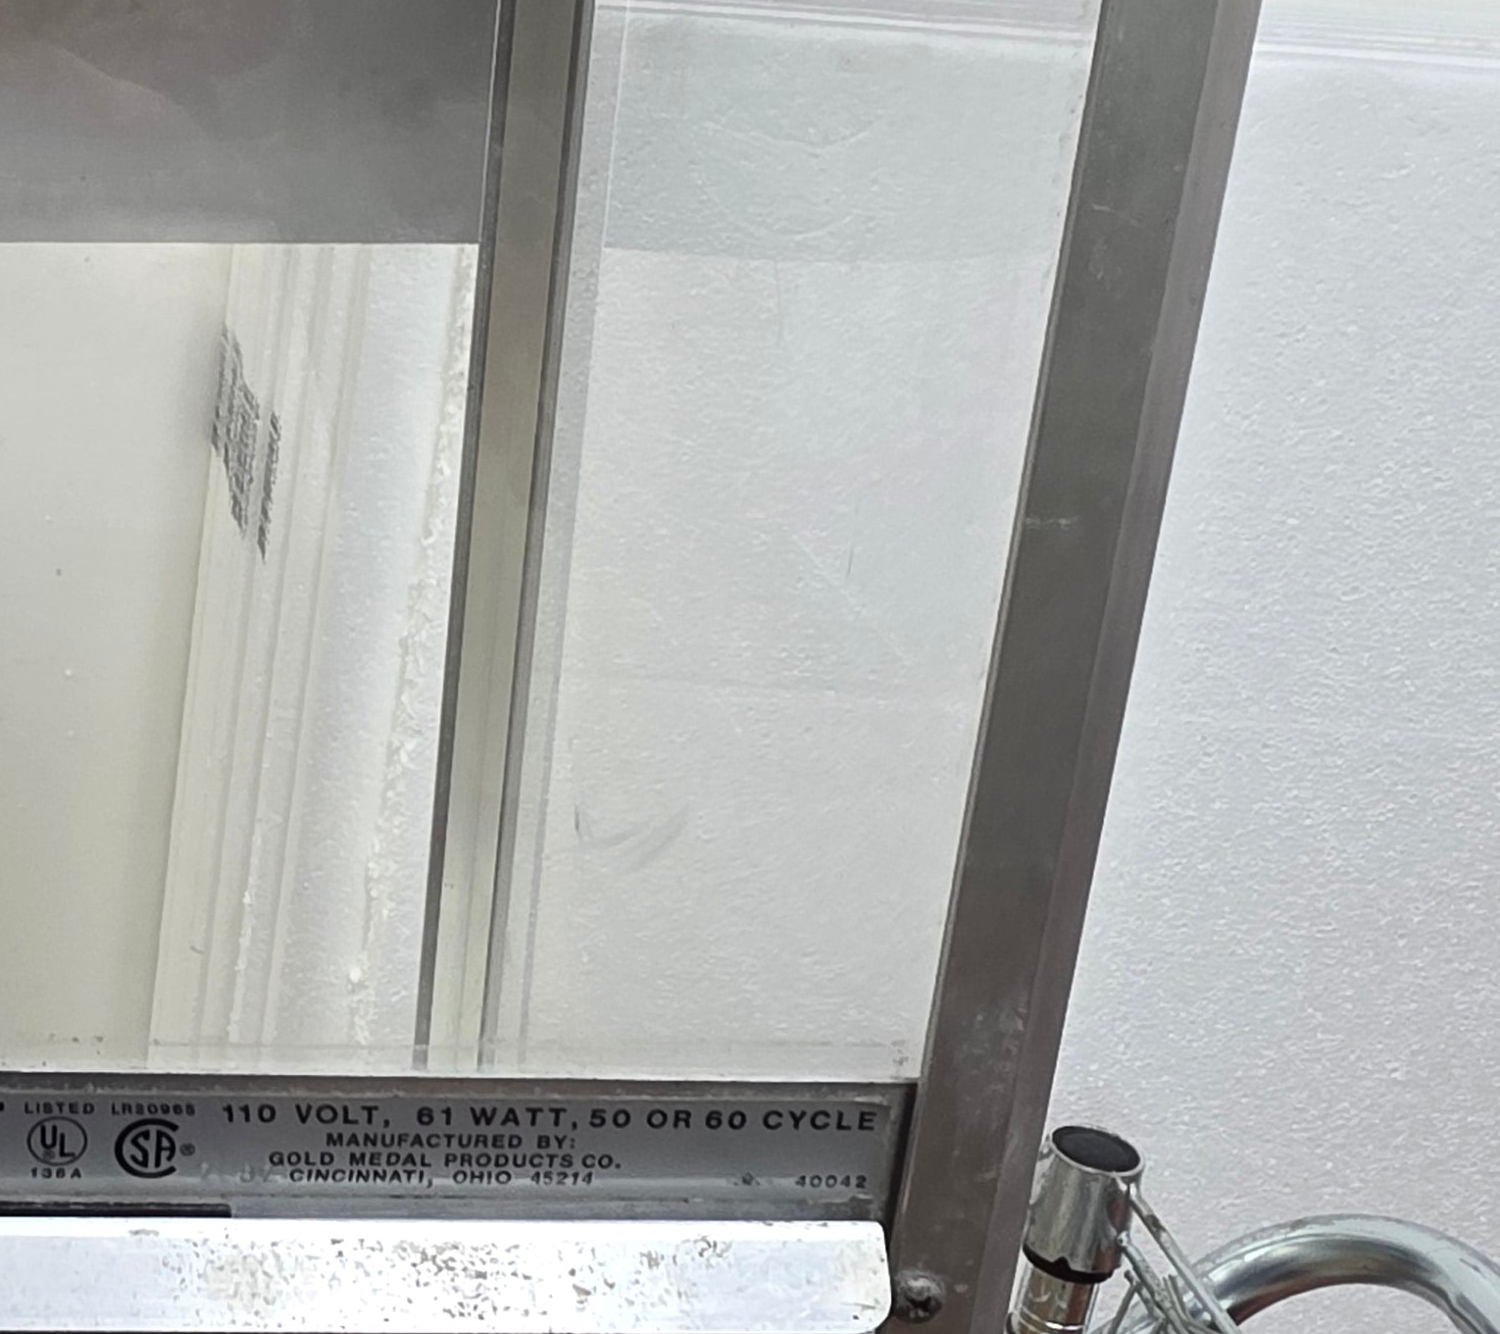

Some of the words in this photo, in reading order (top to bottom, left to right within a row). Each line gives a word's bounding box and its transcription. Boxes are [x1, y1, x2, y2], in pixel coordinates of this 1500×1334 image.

[24, 1101, 95, 1115] LISTED
[222, 1103, 277, 1124] 110
[295, 1103, 390, 1129] VOLT,
[416, 1106, 452, 1126] 61
[470, 1107, 579, 1131] WATT,
[589, 1108, 632, 1129] 50
[647, 1109, 692, 1129] OR
[704, 1110, 747, 1130] 60
[762, 1110, 878, 1132] CYCLE
[326, 1133, 523, 1150] MANUFACTURED
[536, 1134, 576, 1150] BY:
[269, 1151, 335, 1166] GOLD
[349, 1152, 432, 1168] MEDAL
[444, 1152, 573, 1169] PRODUCTS
[581, 1154, 621, 1169] CO.
[289, 1168, 433, 1188] CINCINNATI,
[452, 1170, 513, 1186] OHIO
[530, 1170, 594, 1186] 45214
[795, 1174, 868, 1189] 40042
